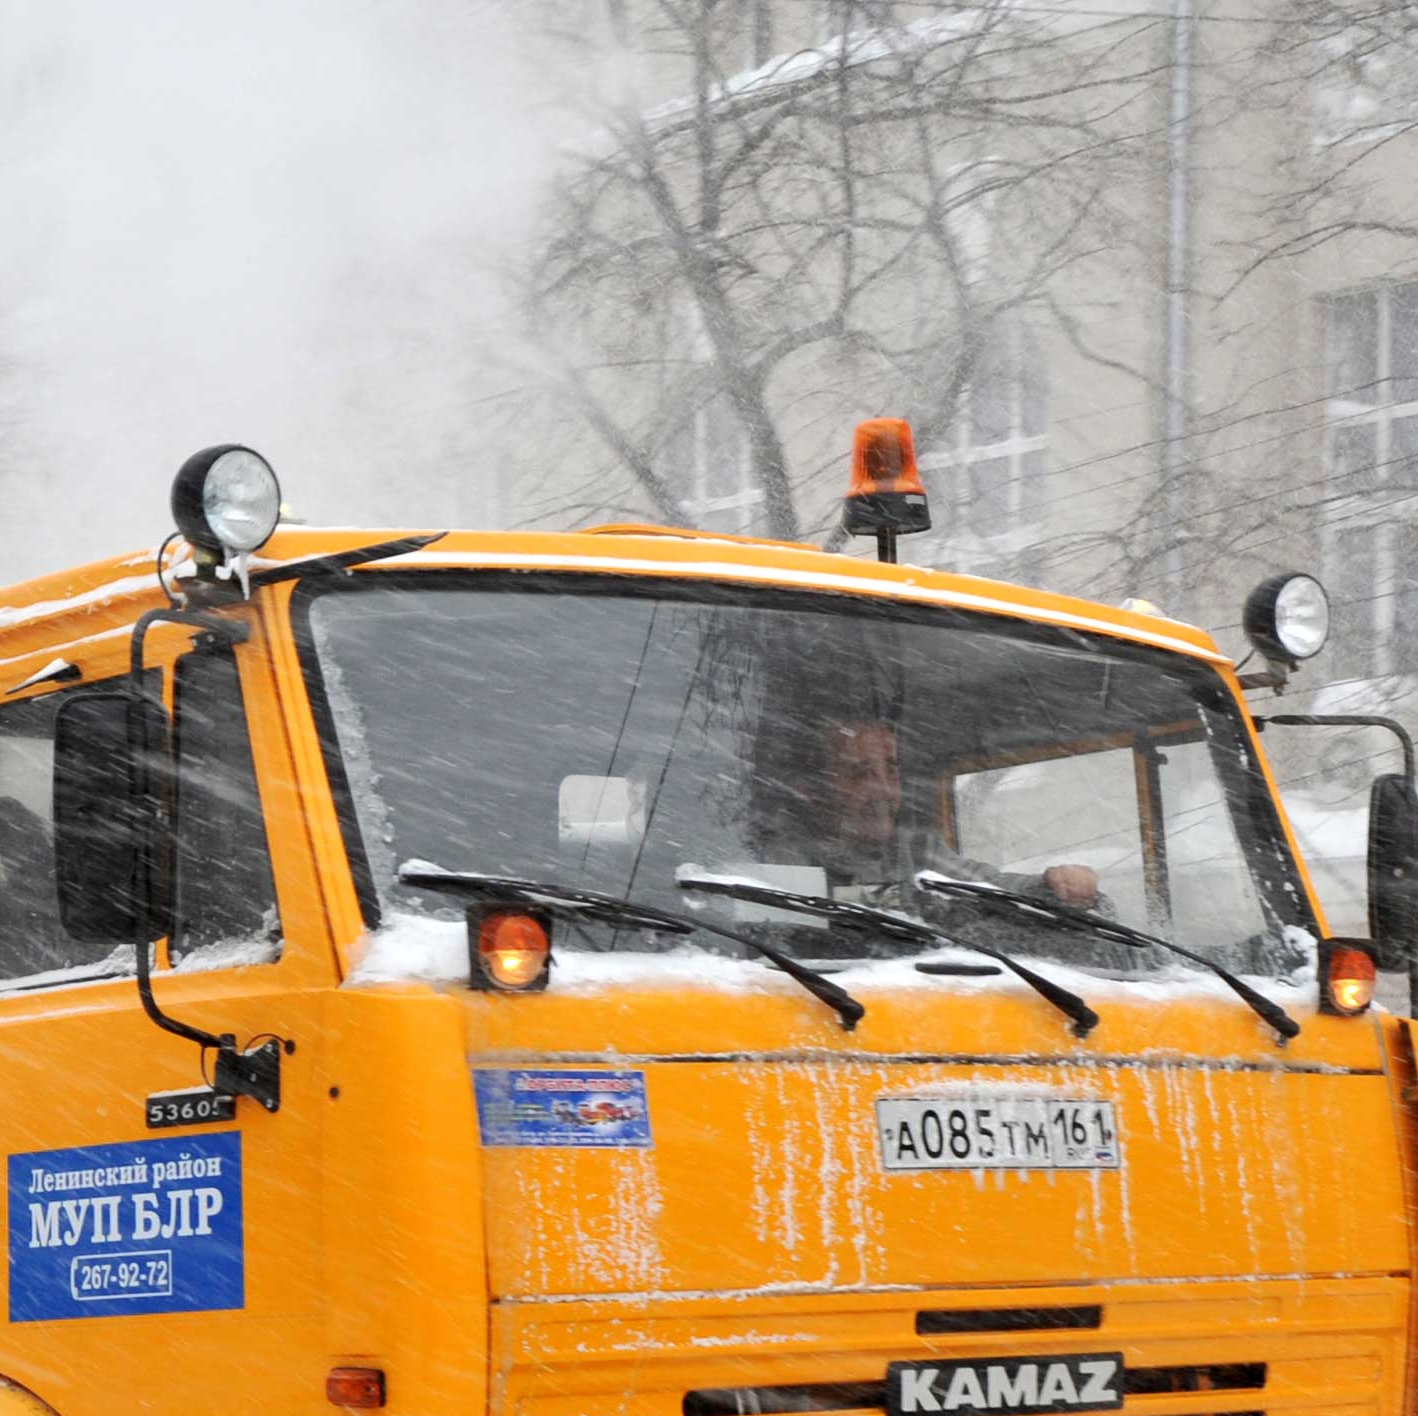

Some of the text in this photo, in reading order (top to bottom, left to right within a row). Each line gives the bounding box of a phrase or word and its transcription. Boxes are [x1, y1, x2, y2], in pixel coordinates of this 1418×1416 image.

[28, 1152, 221, 1194] Ленинский район
[28, 1187, 223, 1248] МУП БЛР
[81, 1260, 168, 1291] 267-92-72
[900, 1360, 1117, 1412] KAMAZ
